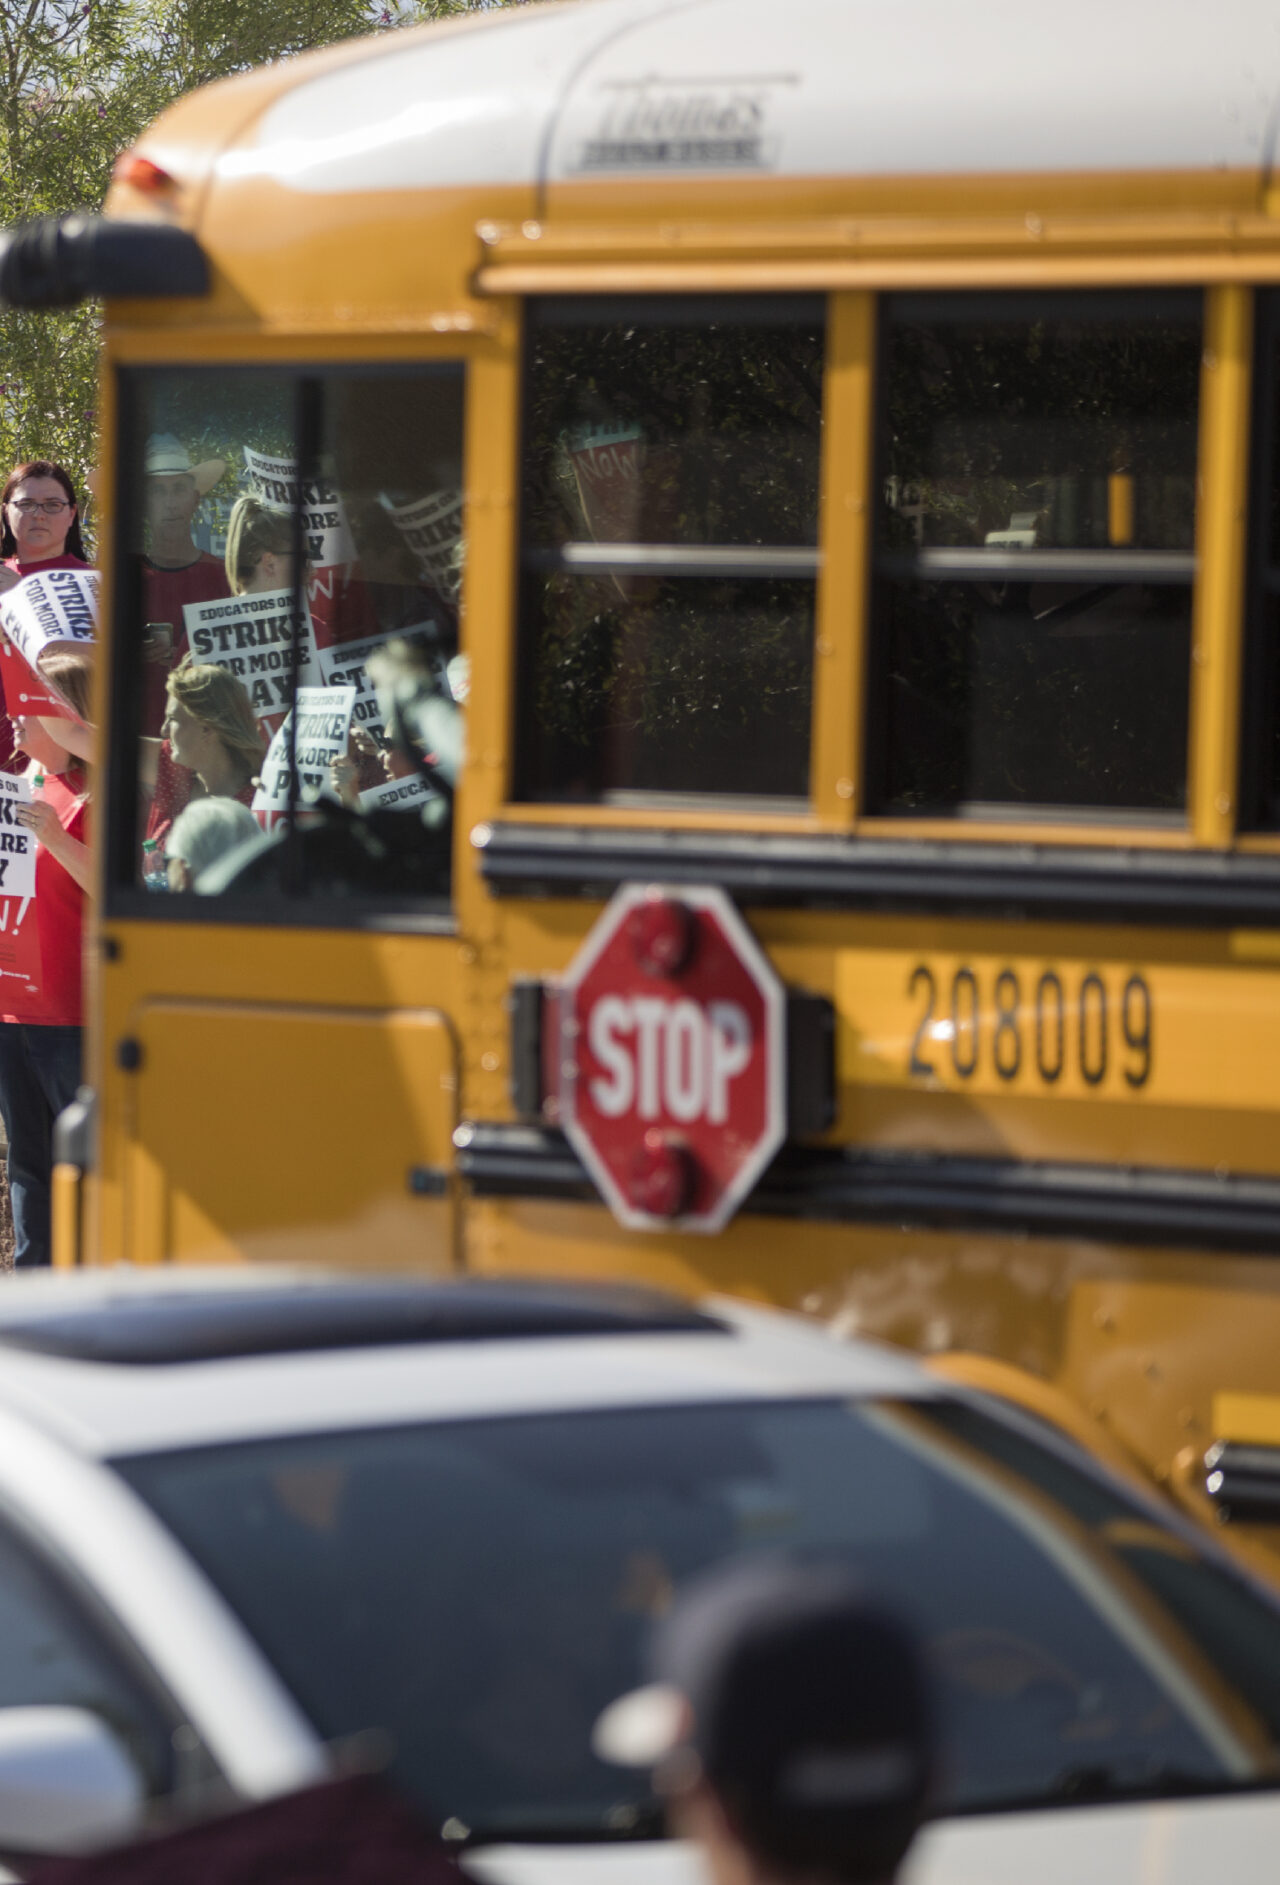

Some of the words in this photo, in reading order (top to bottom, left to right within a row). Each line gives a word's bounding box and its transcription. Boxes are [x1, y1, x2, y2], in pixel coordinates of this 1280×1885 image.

[24, 578, 47, 603] FOR
[48, 572, 98, 640] STRIKE
[35, 602, 64, 638] MORE
[200, 599, 275, 620] EDUCATORS
[193, 612, 310, 656] STRIKE
[248, 646, 311, 674] MORE
[6, 781, 19, 793] ON
[907, 965, 1153, 1089] 208009
[589, 996, 752, 1124] STOP
